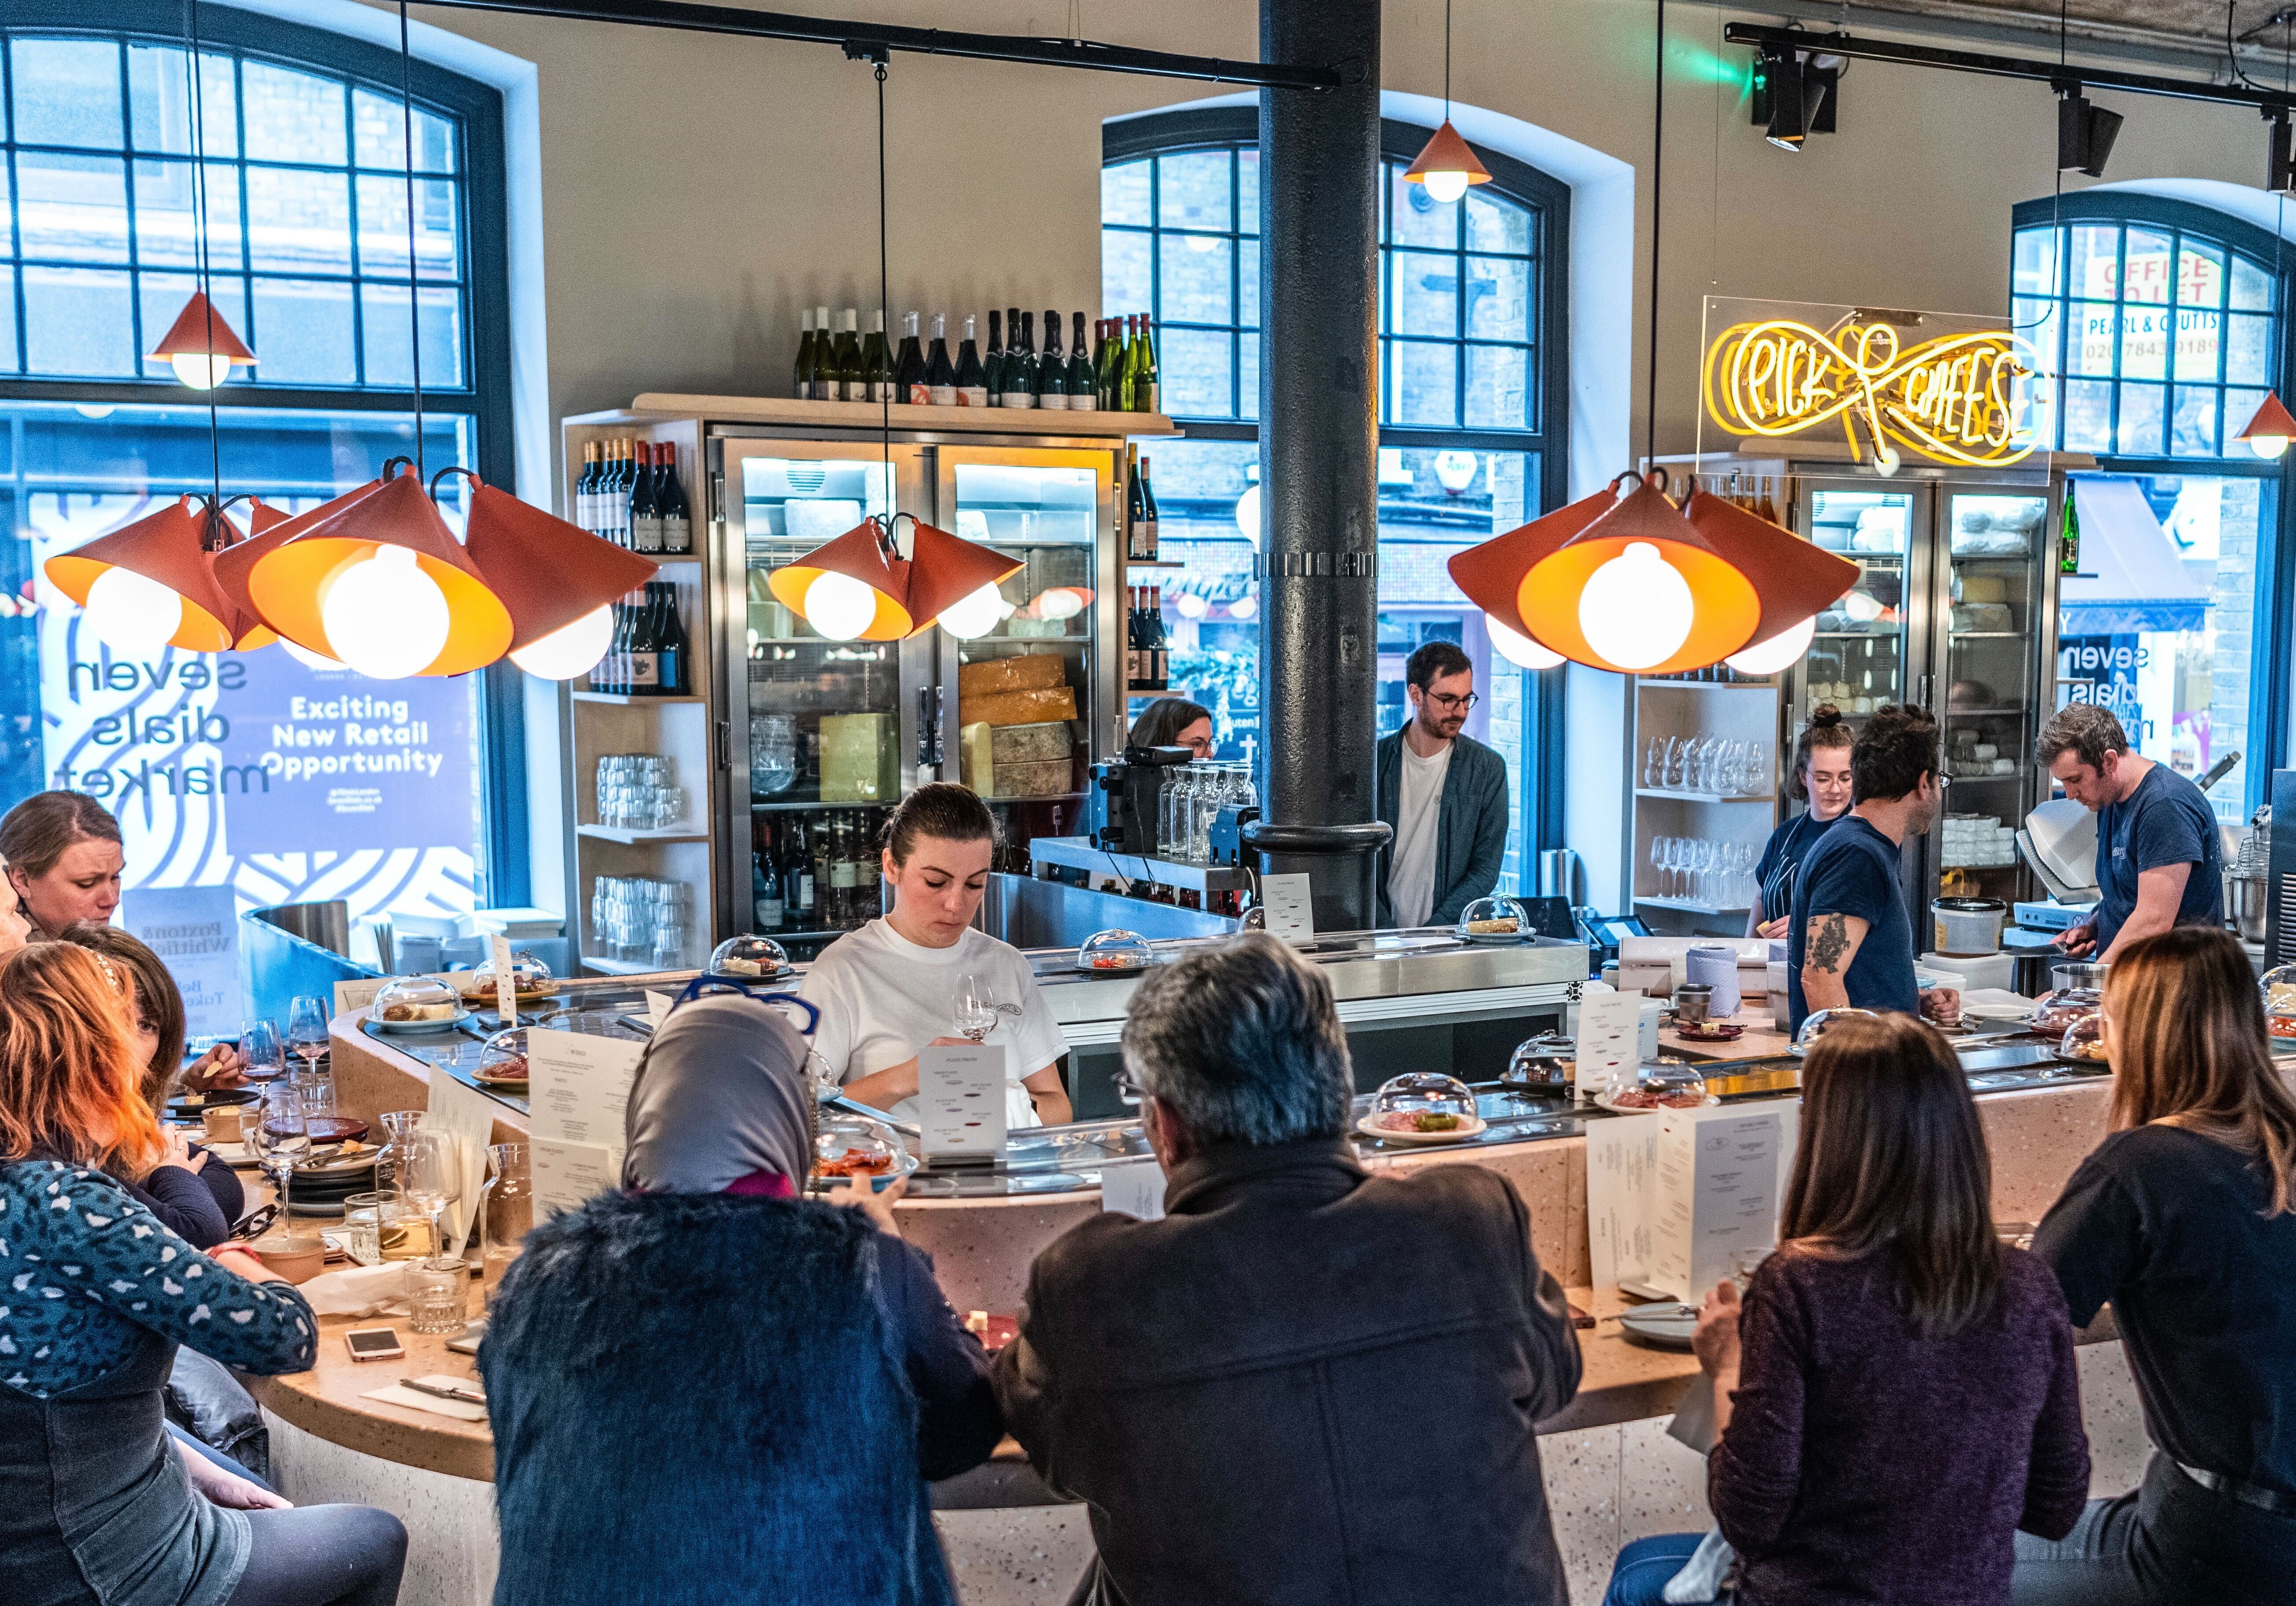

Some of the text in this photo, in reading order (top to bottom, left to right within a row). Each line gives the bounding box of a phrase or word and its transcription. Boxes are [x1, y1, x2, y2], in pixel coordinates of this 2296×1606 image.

[2104, 257, 2209, 283] OFFICE
[2143, 316, 2152, 332] &
[1749, 338, 2035, 447] PICK CHEESE
[291, 694, 409, 724] Exciting
[272, 721, 428, 748] New Retail
[260, 748, 443, 782] Opportunity
